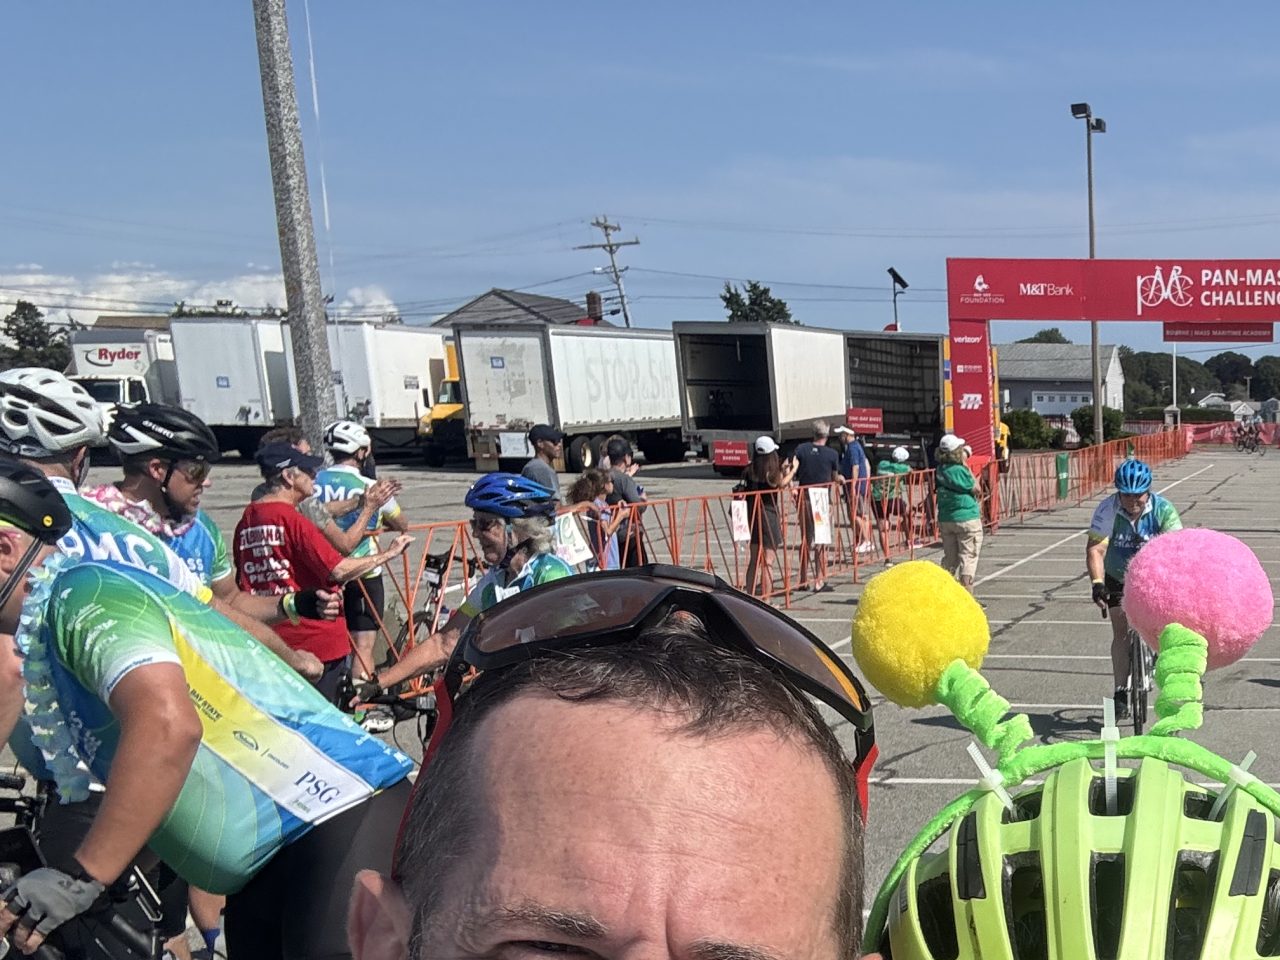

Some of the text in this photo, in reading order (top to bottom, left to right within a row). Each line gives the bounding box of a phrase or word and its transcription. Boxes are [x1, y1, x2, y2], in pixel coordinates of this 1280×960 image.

[953, 335, 981, 343] verizon
[98, 348, 141, 362] Ryder
[201, 700, 223, 720] STATE
[294, 770, 341, 805] PSG
